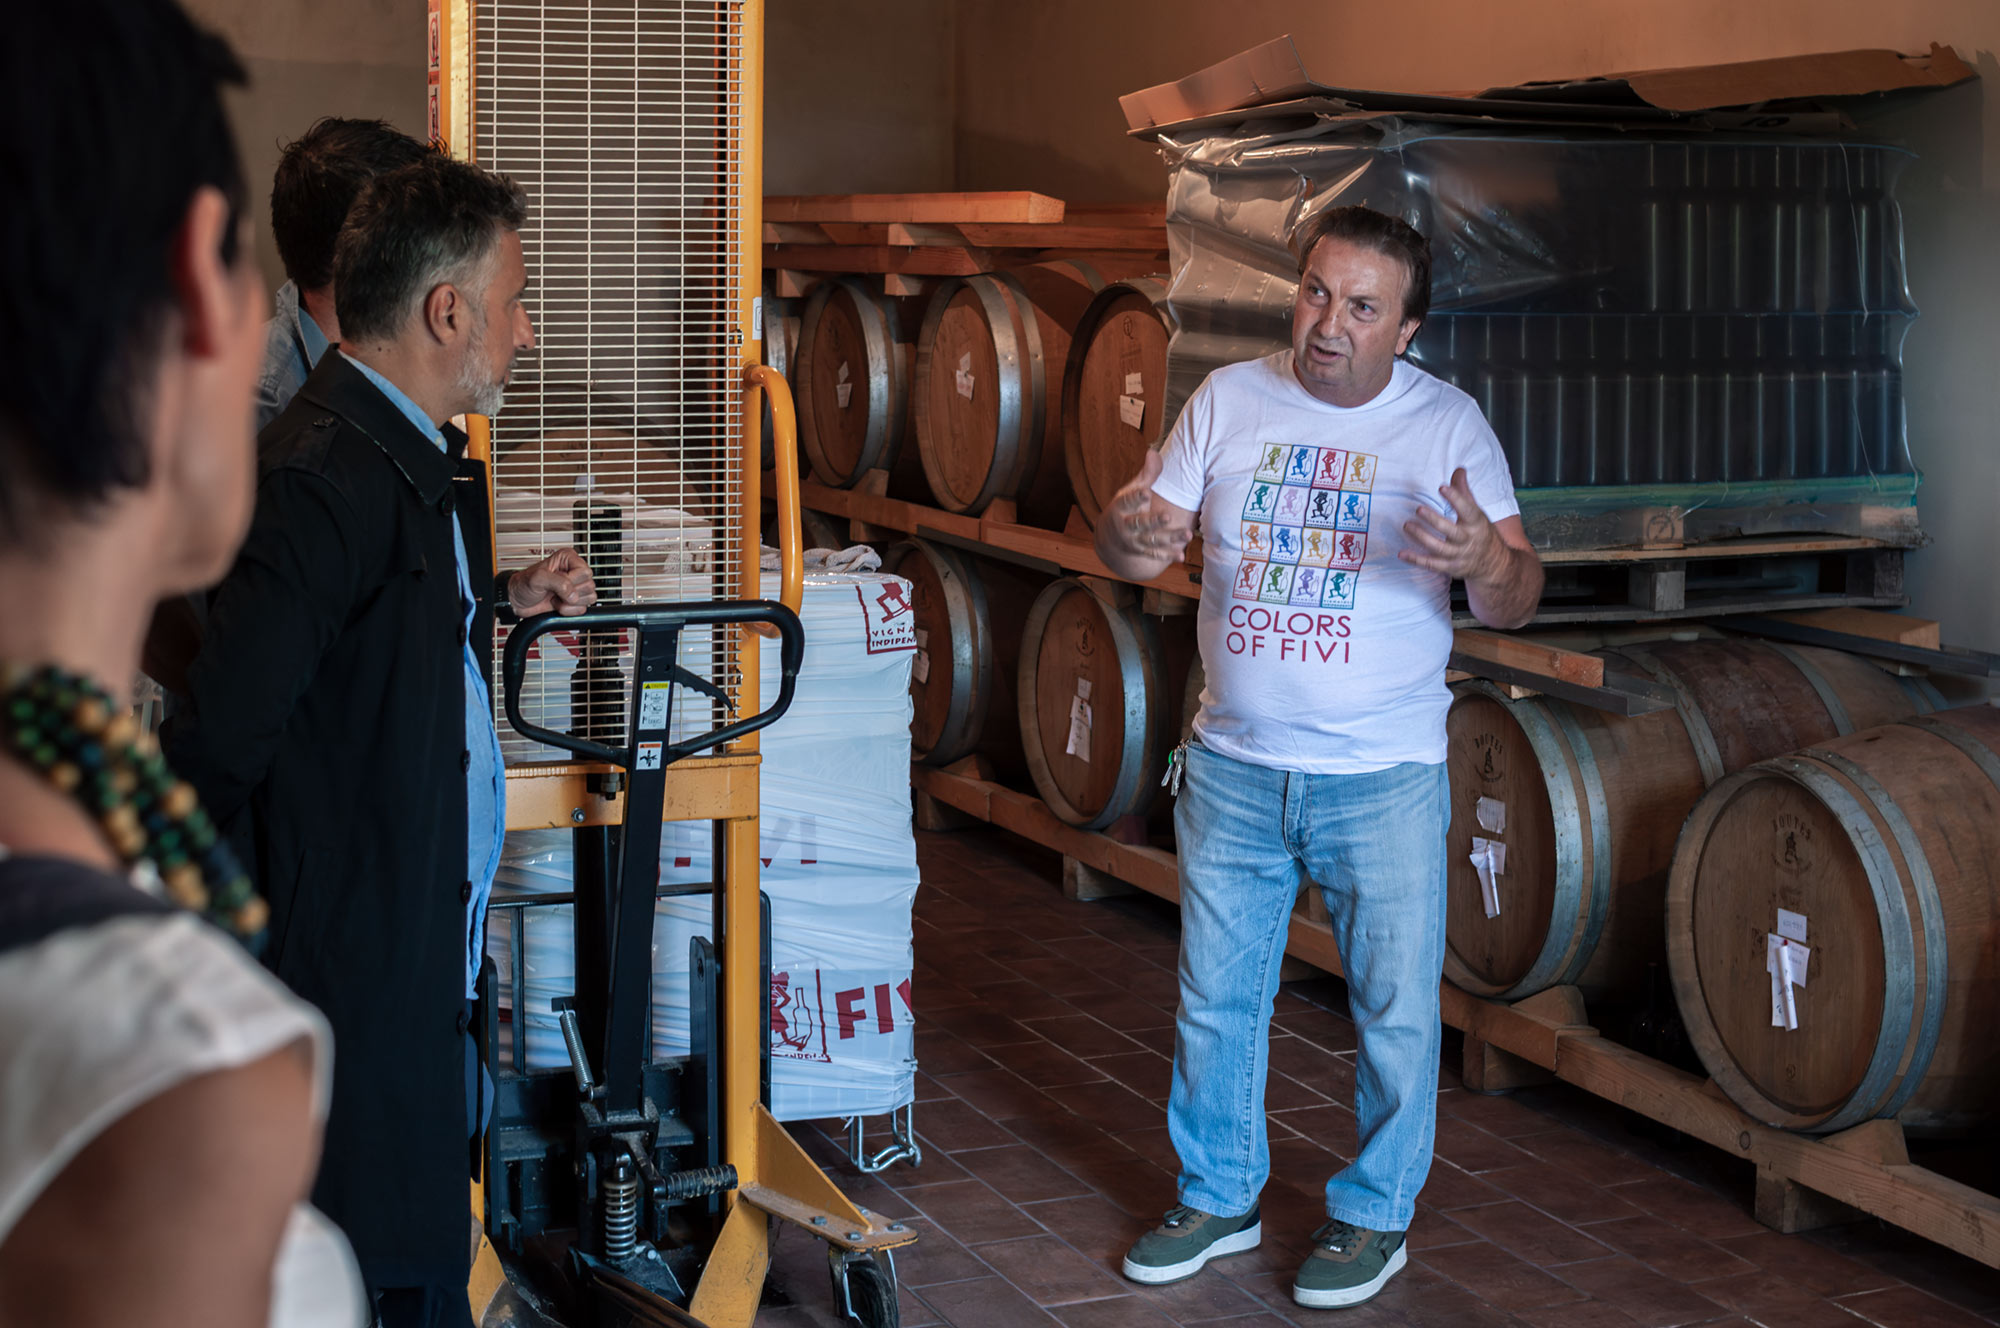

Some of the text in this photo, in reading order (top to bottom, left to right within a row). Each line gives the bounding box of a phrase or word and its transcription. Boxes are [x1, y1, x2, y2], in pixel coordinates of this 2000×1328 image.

[1228, 604, 1351, 638] COLORS
[1226, 631, 1350, 664] OF FIVI
